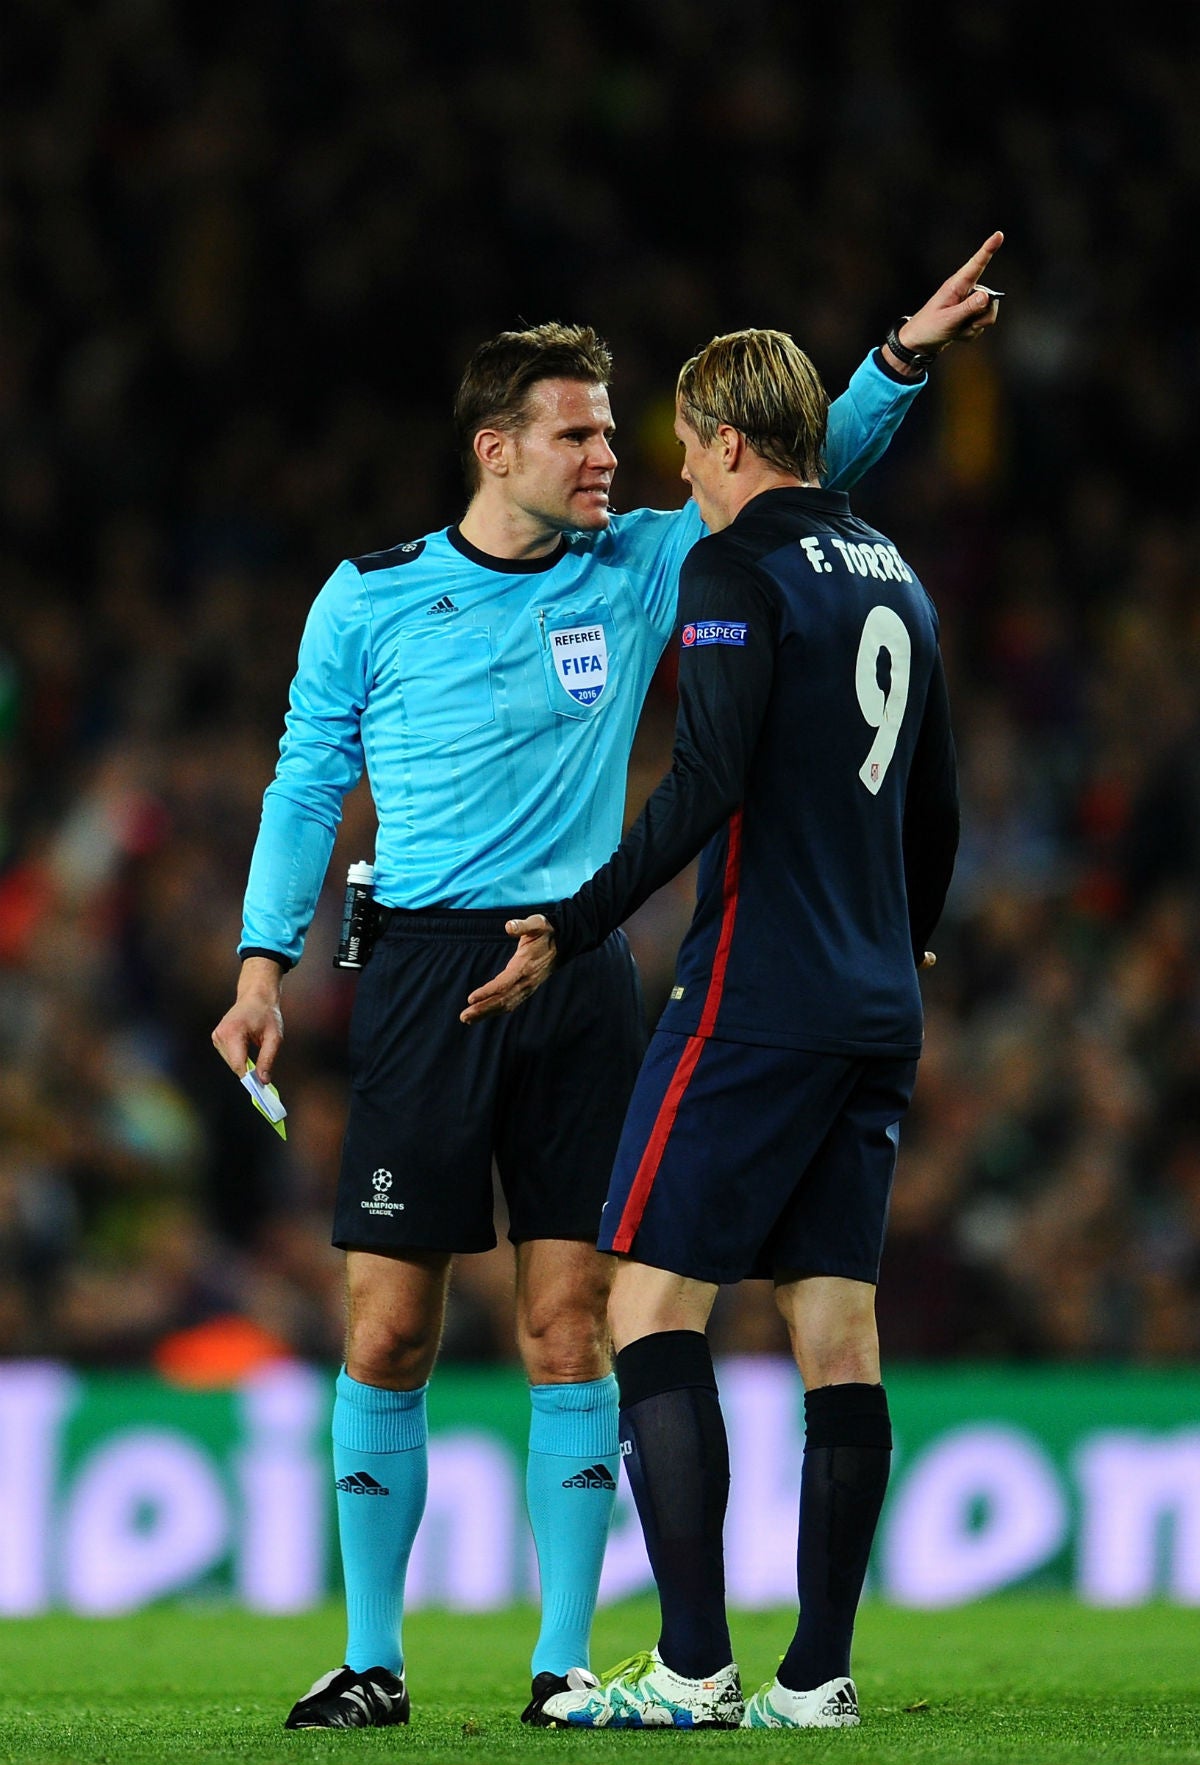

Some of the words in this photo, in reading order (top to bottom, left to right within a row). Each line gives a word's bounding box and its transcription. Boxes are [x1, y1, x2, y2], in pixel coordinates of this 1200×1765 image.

[800, 536, 833, 573] F.
[831, 538, 913, 584] TORRE
[426, 606, 459, 616] adidas
[555, 630, 601, 647] REFEREE
[696, 627, 747, 640] RESPECT
[562, 655, 603, 676] FIFA
[578, 689, 597, 700] 2016
[855, 605, 912, 796] 9
[360, 1201, 405, 1211] CHAMPIONS
[369, 1209, 393, 1217] LEAGUE
[335, 1481, 390, 1496] adidas
[561, 1479, 617, 1491] adidas
[821, 1702, 860, 1717] adida
